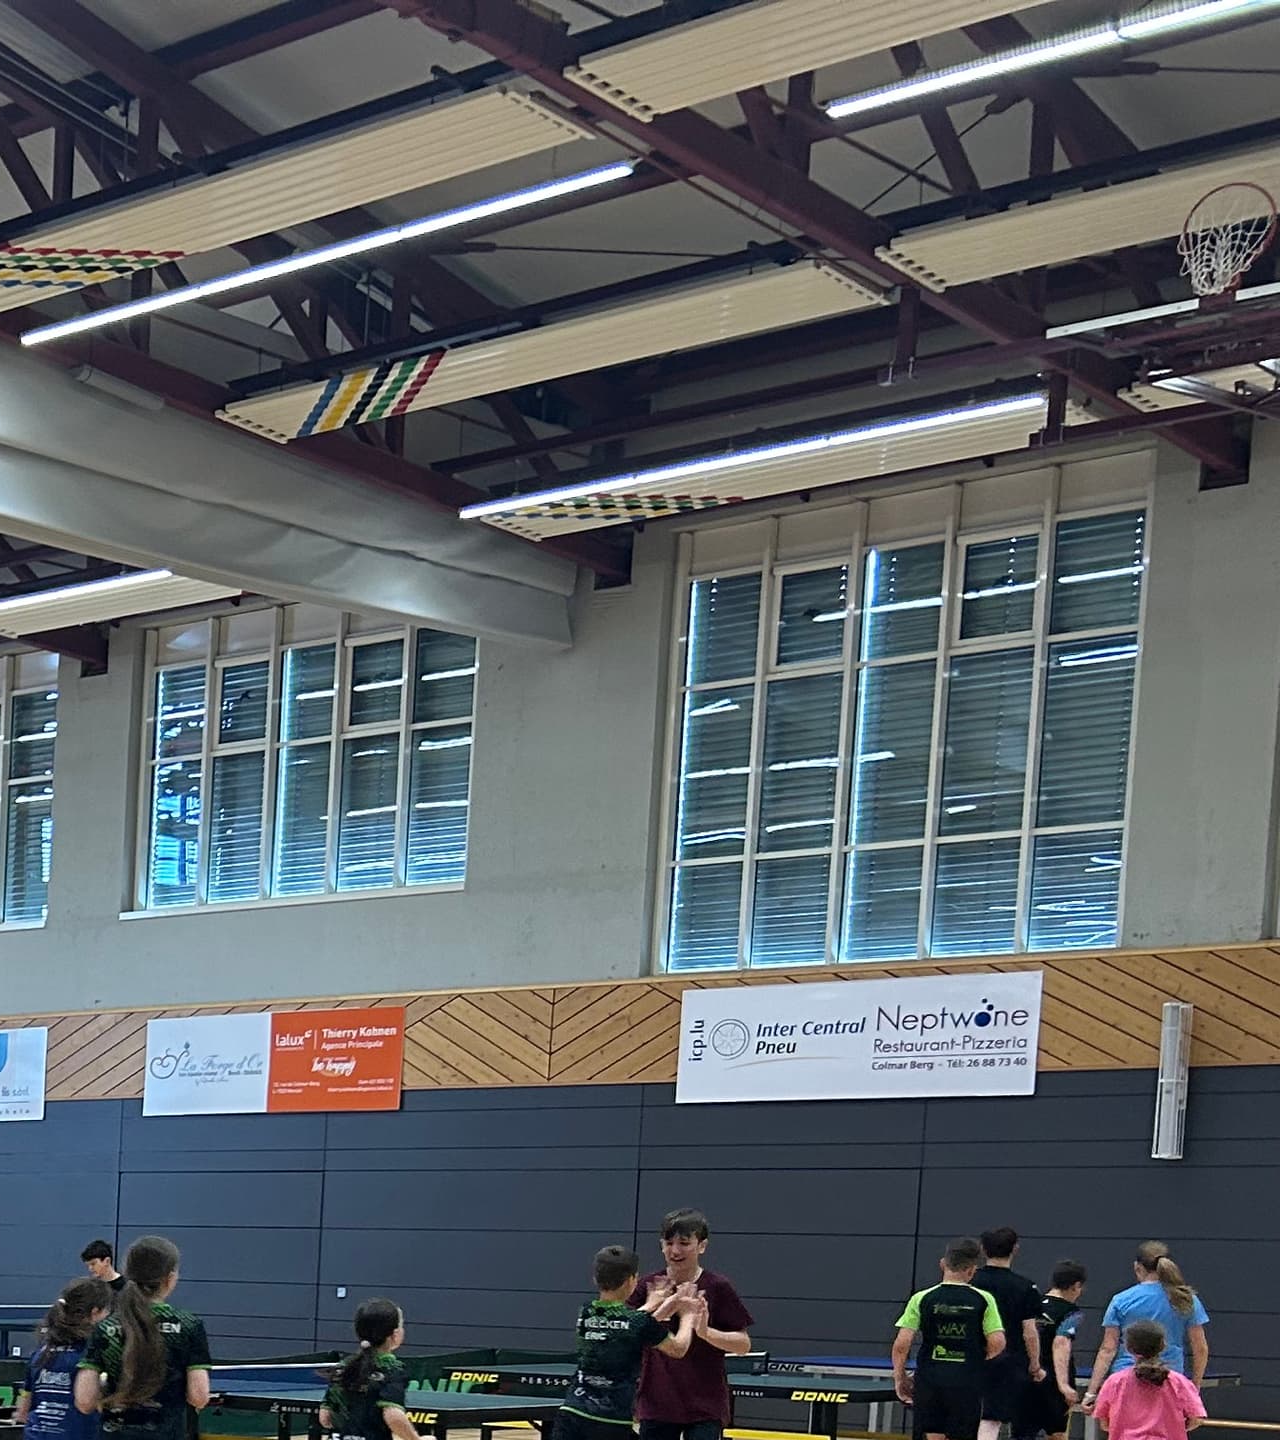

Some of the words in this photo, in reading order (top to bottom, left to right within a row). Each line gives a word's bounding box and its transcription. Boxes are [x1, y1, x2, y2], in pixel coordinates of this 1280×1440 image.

[322, 1027, 357, 1039] Thierry
[756, 1023, 797, 1037] Inter
[802, 1017, 866, 1035] Central
[275, 1034, 305, 1046] lalux
[688, 1019, 707, 1061] icp.lu
[873, 1035, 1028, 1054] Restaurant-Pizzeria
[755, 1041, 797, 1055] Pneu
[872, 1062, 907, 1071] Colmar
[910, 1060, 934, 1070] Berg
[966, 1059, 979, 1068] 26
[982, 1058, 995, 1067] 88
[998, 1058, 1011, 1067] 73
[1013, 1057, 1027, 1066] 40
[451, 1372, 500, 1383] DONIC
[521, 1377, 570, 1385] PERSSO
[791, 1391, 849, 1403] DONIC
[406, 1413, 438, 1424] NIC
